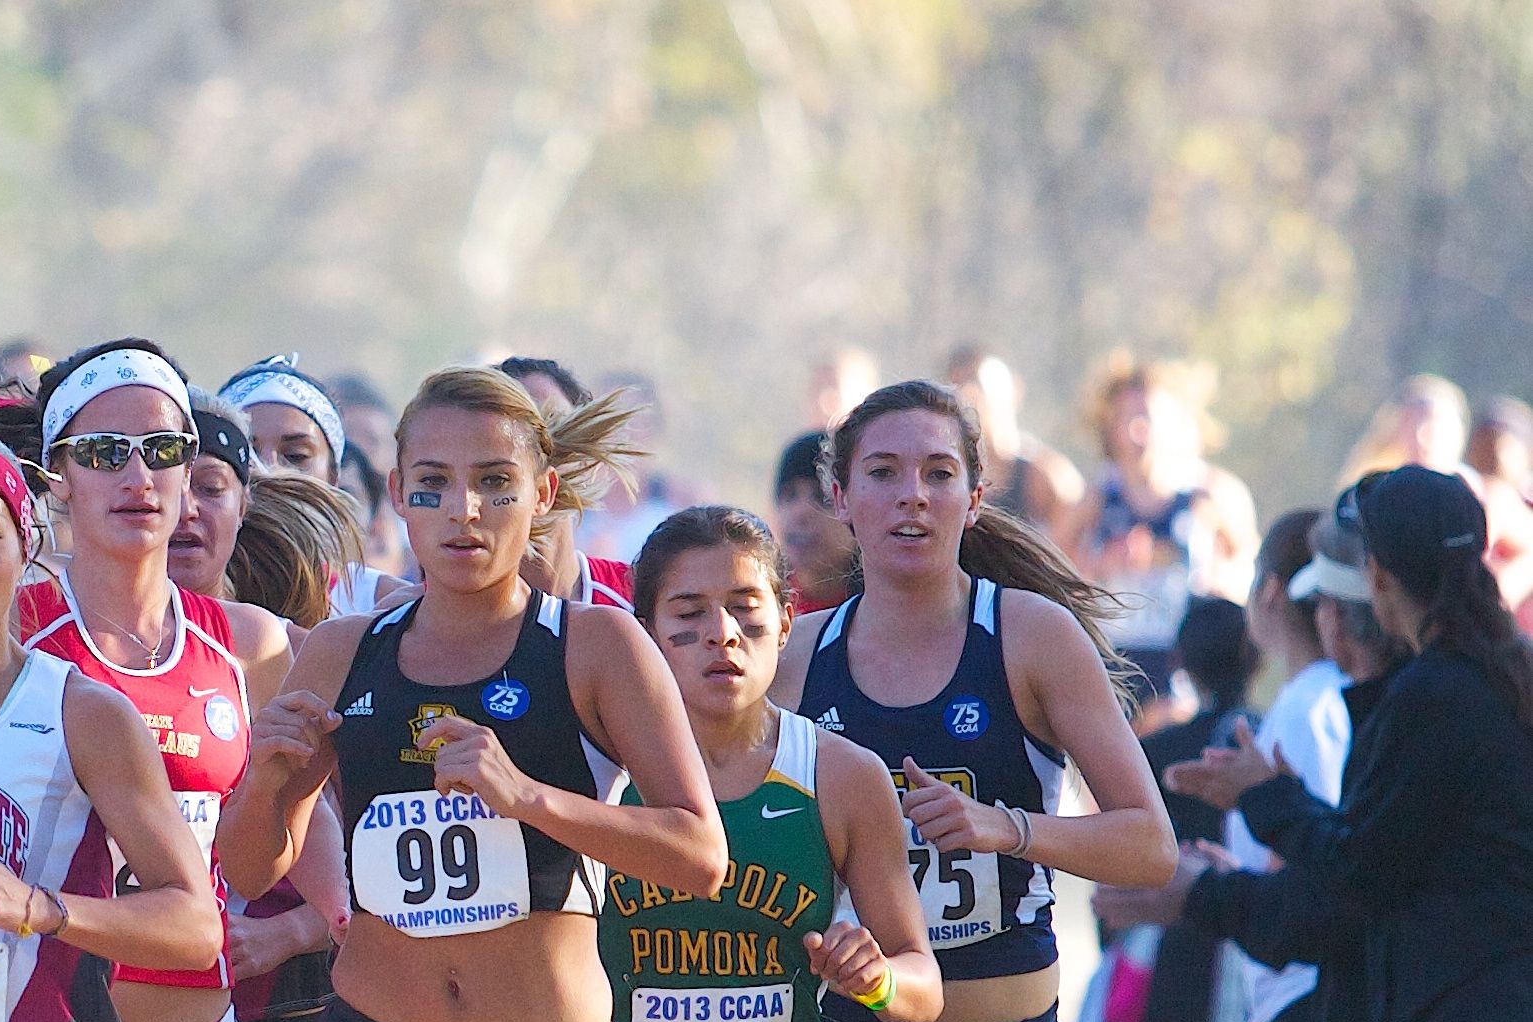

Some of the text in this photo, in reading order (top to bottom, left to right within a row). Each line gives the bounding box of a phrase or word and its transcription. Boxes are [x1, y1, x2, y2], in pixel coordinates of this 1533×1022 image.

[489, 684, 522, 707] 75
[344, 707, 374, 716] adidas
[953, 702, 980, 726] 75
[180, 799, 208, 823] AA
[362, 798, 427, 830] 2013
[396, 824, 480, 905] 99
[378, 901, 520, 930] HAMPIONSHIPS
[629, 927, 786, 977] POMONA
[645, 992, 784, 1021] 2013 CCAA
